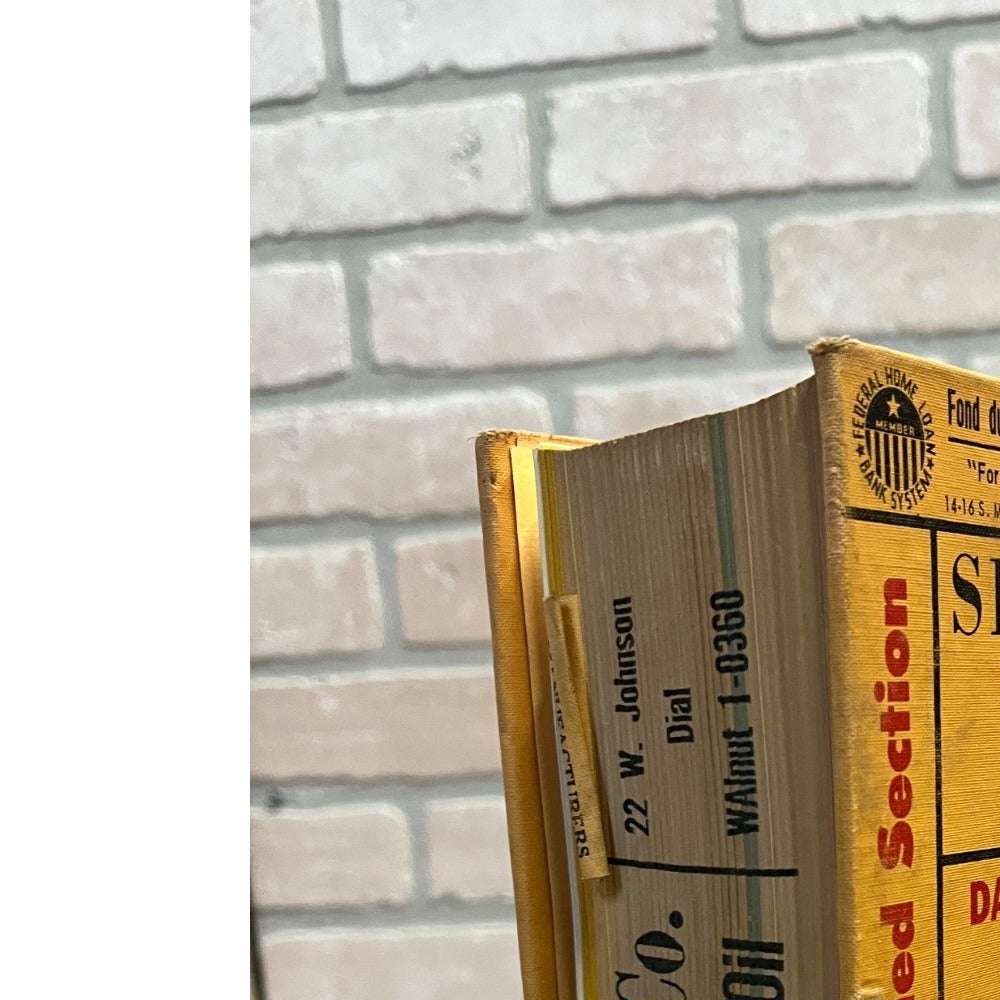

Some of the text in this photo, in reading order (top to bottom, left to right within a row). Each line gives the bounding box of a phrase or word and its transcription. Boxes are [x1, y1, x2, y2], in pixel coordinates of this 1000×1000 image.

[852, 366, 936, 456] FEDERAL HOME LOAN
[875, 420, 915, 436] MEMBER
[947, 388, 980, 431] Fond
[859, 459, 932, 510] BANK SYSTEM
[978, 501, 990, 517] S.
[613, 596, 650, 837] 22 W. Johnson
[663, 688, 695, 744] Dial
[710, 590, 760, 837] WAlnut 1-0360
[874, 577, 915, 870] Section
